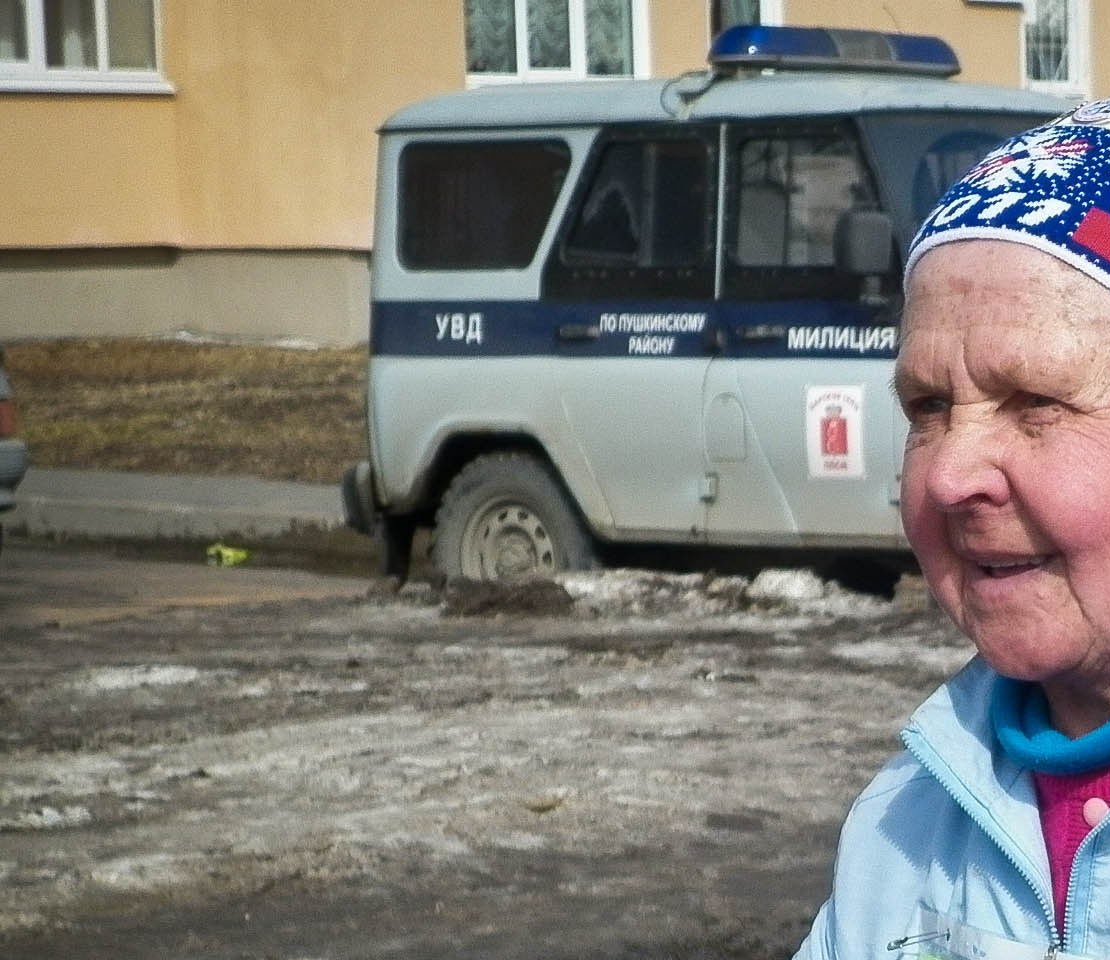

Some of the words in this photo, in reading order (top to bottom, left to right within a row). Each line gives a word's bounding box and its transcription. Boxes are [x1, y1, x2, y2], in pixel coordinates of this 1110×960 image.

[435, 312, 482, 345] УВД
[600, 312, 618, 332] ПО
[618, 312, 706, 332] ПУШКИНСКОМУ
[628, 335, 675, 355] РАЙОНУ
[787, 325, 898, 353] МИЛИЦИЯ
